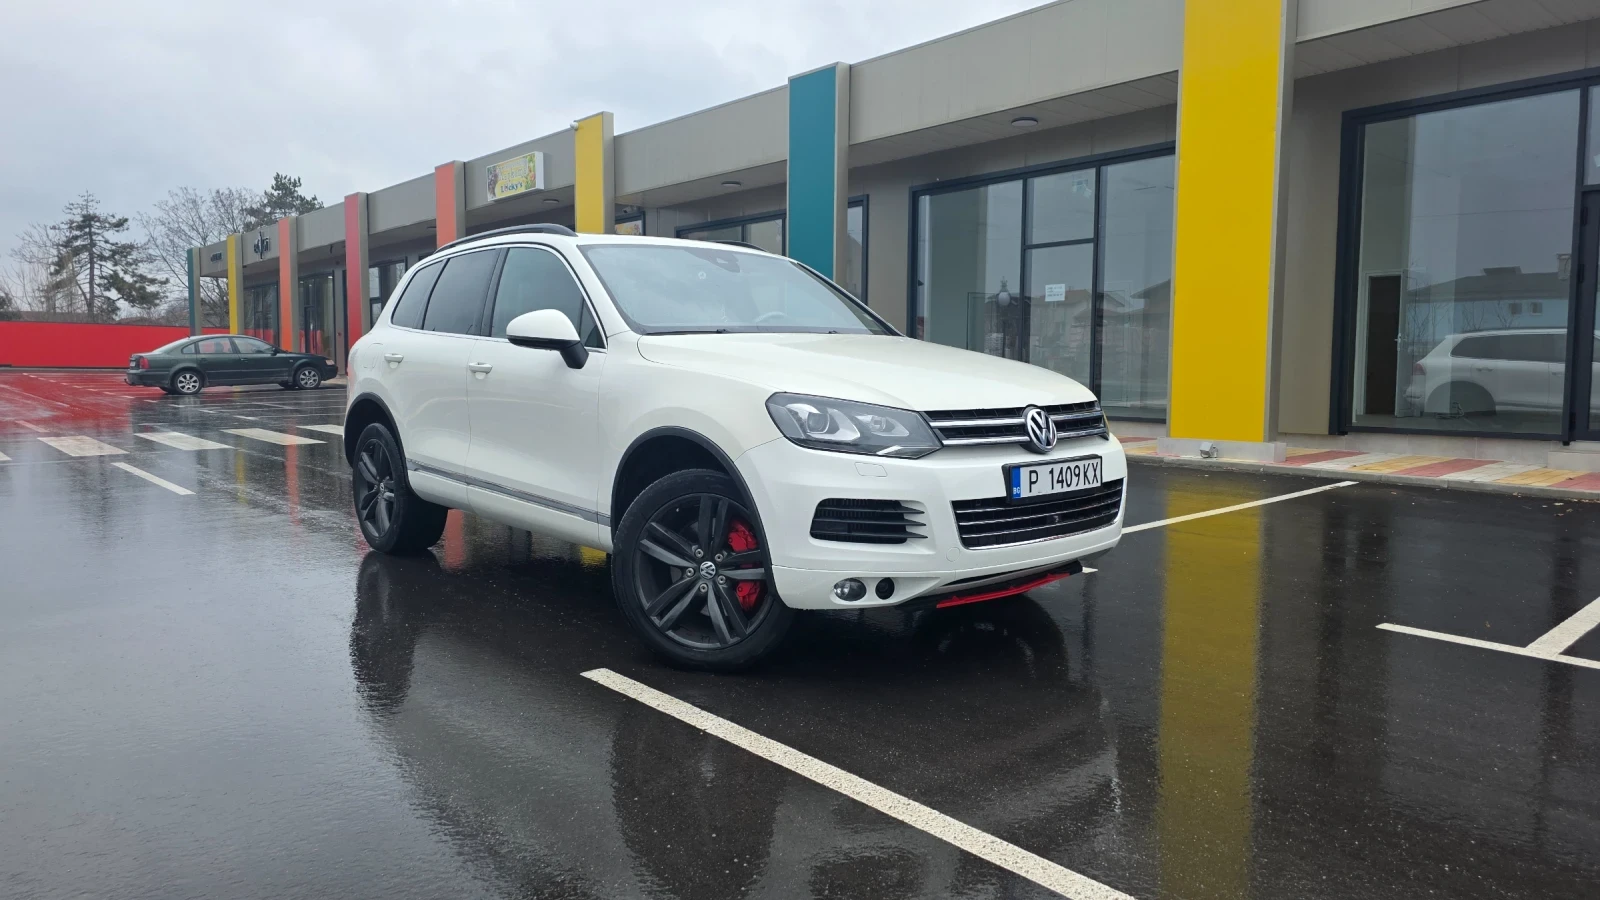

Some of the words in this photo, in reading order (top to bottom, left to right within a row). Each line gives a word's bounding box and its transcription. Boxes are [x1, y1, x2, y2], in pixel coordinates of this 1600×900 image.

[1029, 470, 1039, 493] P
[1048, 461, 1099, 490] 1409KX
[1013, 487, 1021, 495] BG
